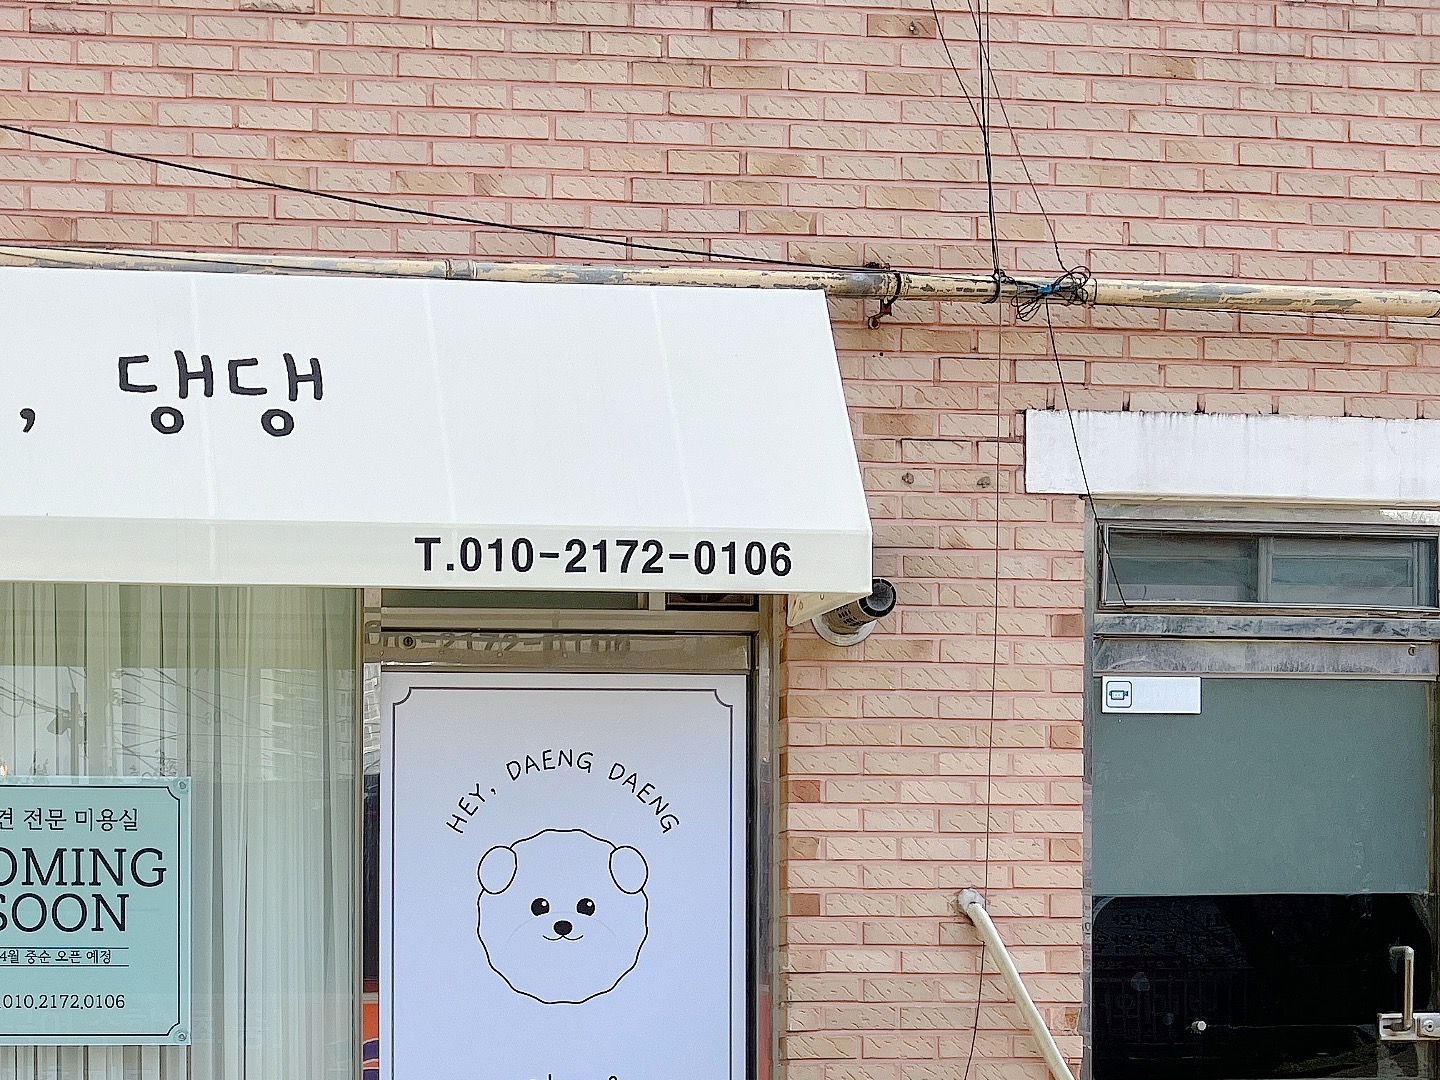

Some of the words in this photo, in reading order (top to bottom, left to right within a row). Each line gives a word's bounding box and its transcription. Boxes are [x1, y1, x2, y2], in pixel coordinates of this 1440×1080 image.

[118, 350, 323, 437] 댕댕
[415, 537, 791, 576] T.010-2172-0106
[446, 783, 497, 834] HEY,
[506, 749, 594, 782] DAENG
[608, 762, 680, 834] DAENG
[23, 807, 67, 831] 전문
[75, 807, 138, 832] 미용실
[0, 950, 20, 964] 4월
[24, 950, 52, 964] 중순
[55, 950, 82, 964] 오픈
[86, 950, 112, 964] 예정
[3, 994, 125, 1010] 010.2172.0106
